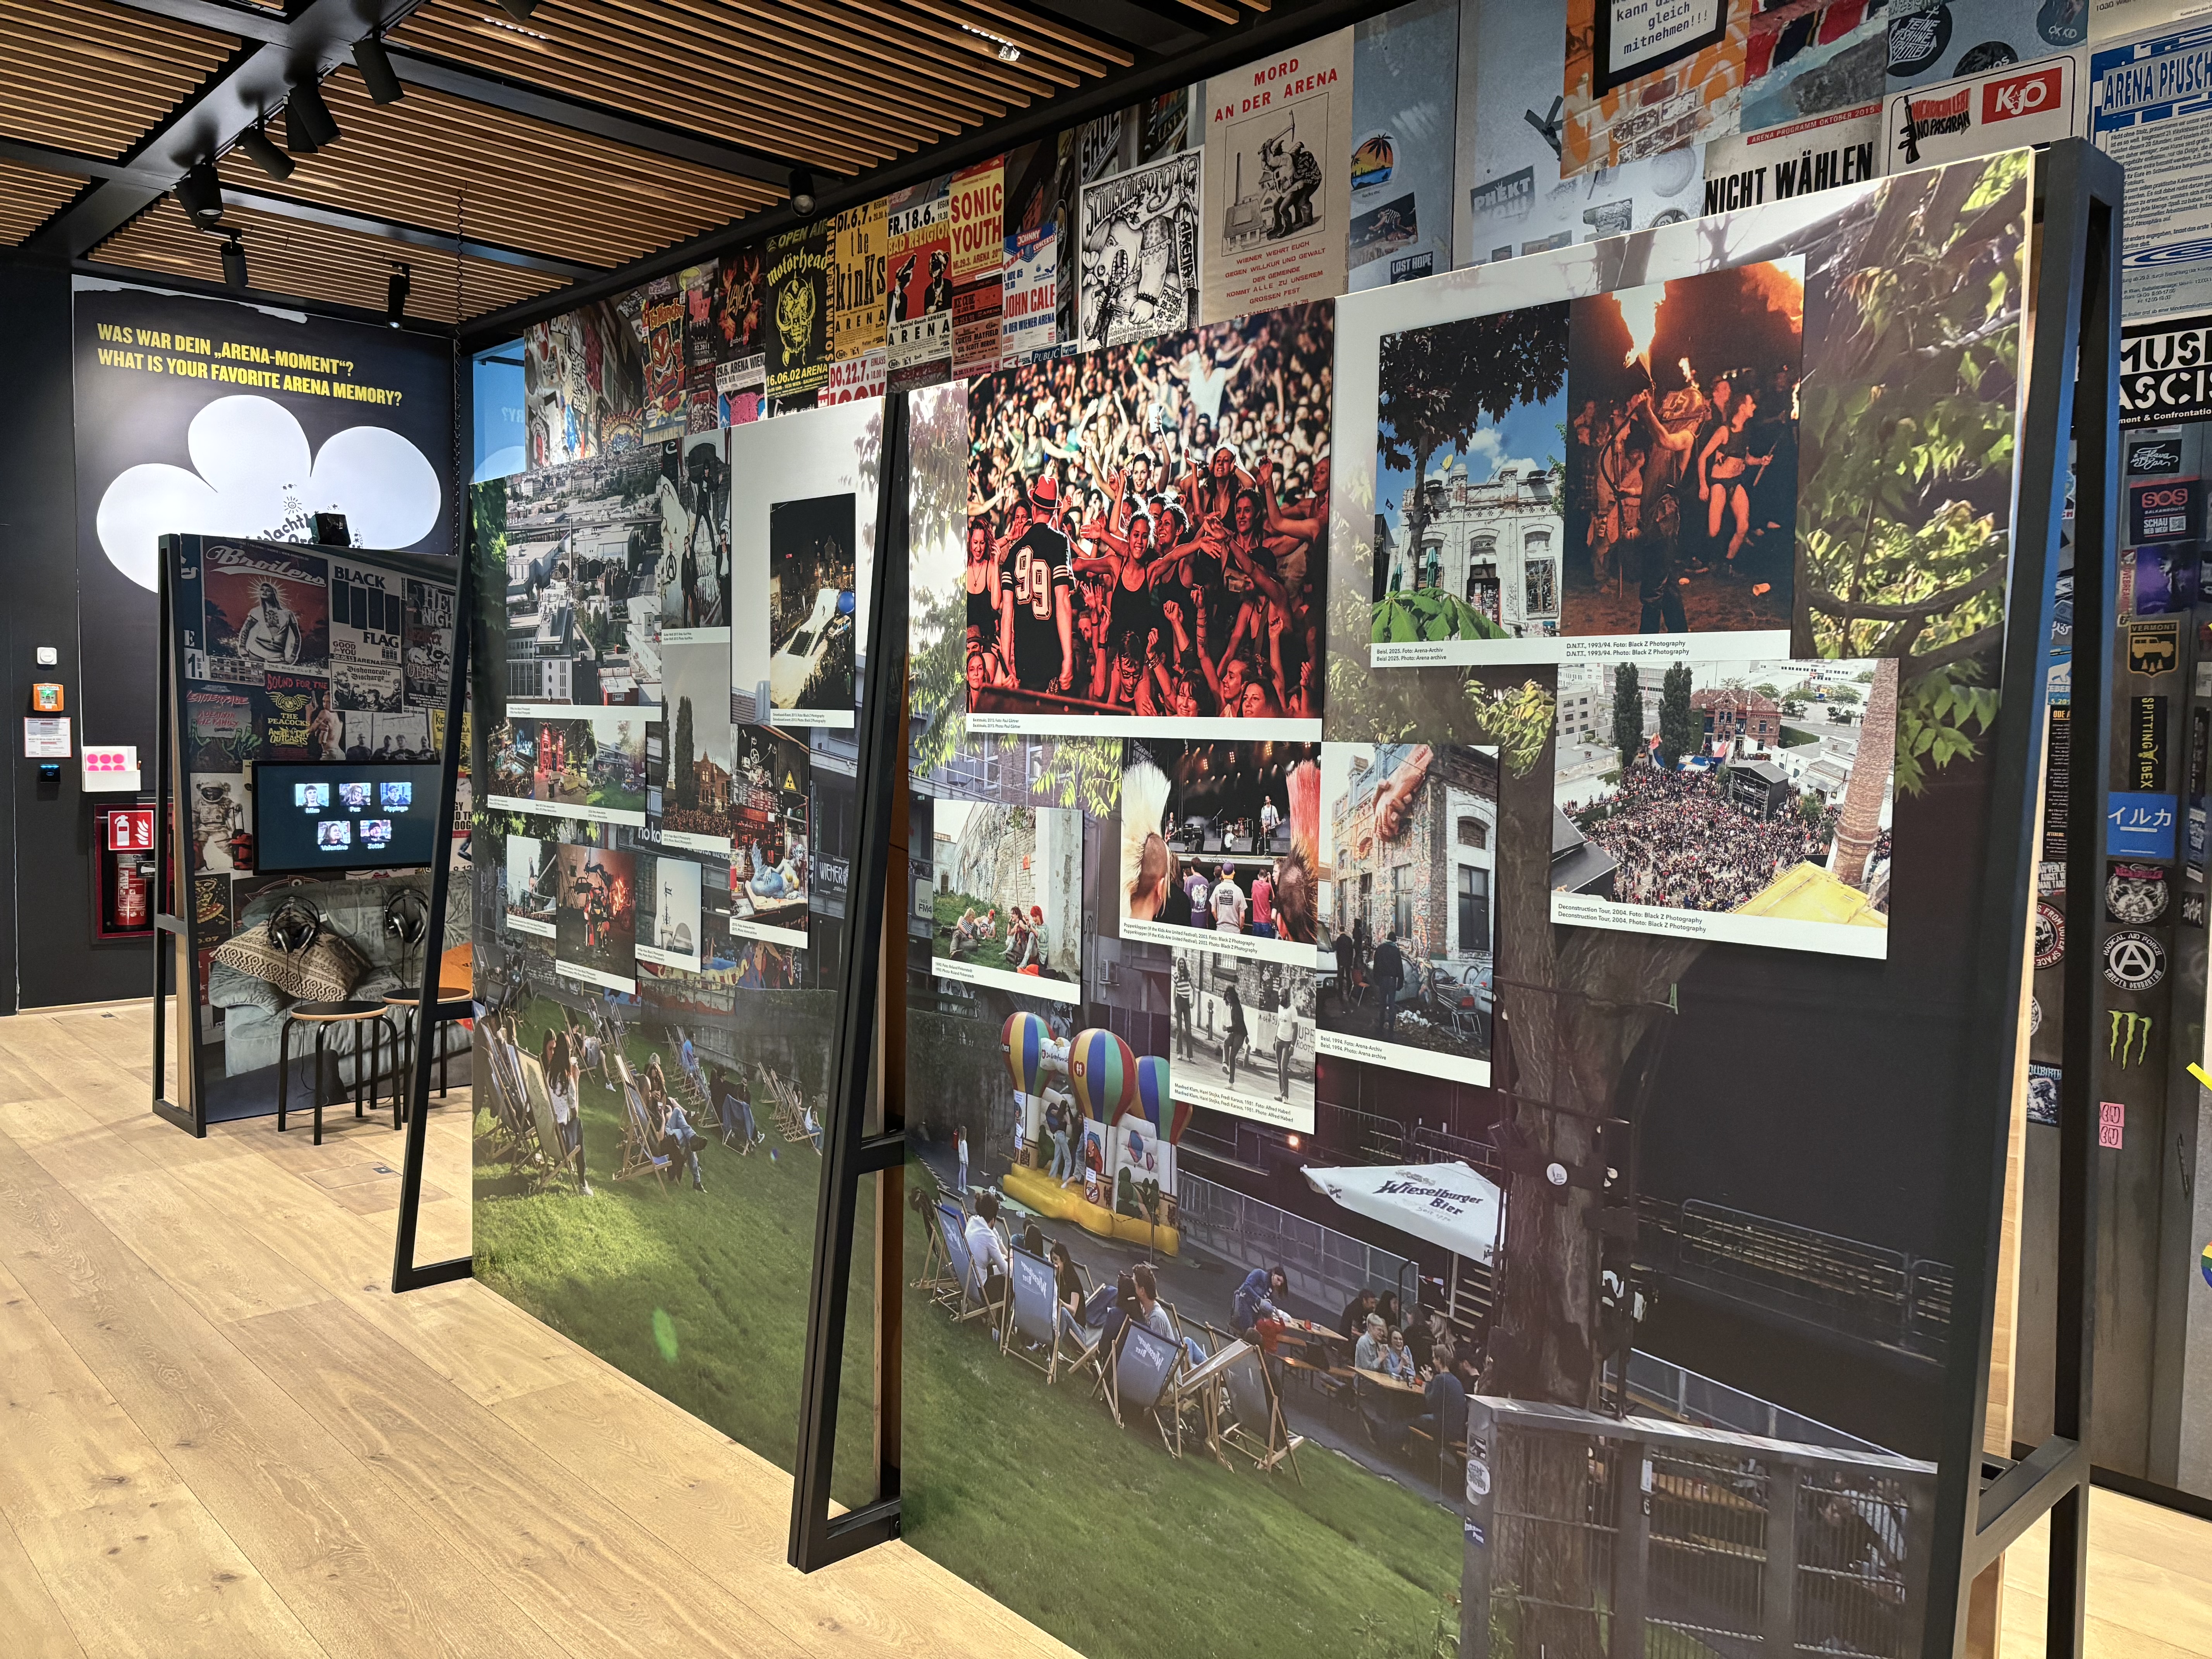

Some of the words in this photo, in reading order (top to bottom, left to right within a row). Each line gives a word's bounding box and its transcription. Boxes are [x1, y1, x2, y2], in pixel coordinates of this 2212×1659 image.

[1617, 2, 1648, 22] kann
[1648, 3, 1690, 30] gleich
[1624, 10, 1707, 55] mitnehmen!!!
[1254, 58, 1299, 86] MORD
[1214, 104, 1234, 123] AN
[1242, 91, 1271, 113] DER
[1284, 67, 1338, 99] ARENA
[2103, 65, 2154, 111] ARENA
[1751, 131, 1774, 143] ARENA
[1776, 120, 1818, 137] PROGRAMM
[1819, 112, 1852, 127] OKTOBER
[1855, 106, 1875, 117] 2015
[1916, 118, 1929, 140] NO
[1930, 110, 1971, 136] PASARAN
[1705, 167, 1767, 216] NICHT
[1776, 141, 1874, 201] WÄHLEN
[951, 182, 1003, 224] SONIC
[778, 232, 806, 249] OPEN
[851, 227, 869, 257] the
[888, 235, 905, 256] BAD
[909, 221, 950, 249] RELIGION
[951, 215, 1002, 256] YOUTH
[1017, 228, 1041, 246] JOHNNY
[1033, 234, 1056, 251] CONCERTS
[1225, 269, 1247, 278] GEGEN
[1282, 256, 1296, 264] UND
[1298, 248, 1326, 259] GEWALT
[1237, 254, 1262, 265] WIENER
[1266, 247, 1290, 257] WEHRT
[1291, 240, 1310, 251] EUCH
[1392, 259, 1410, 274] LOST
[1412, 253, 1432, 270] HOPE
[767, 246, 828, 287] motörhead
[1253, 275, 1265, 283] DER
[1268, 266, 1300, 279] GEMEINDE
[1226, 289, 1250, 298] KOMMT
[1253, 283, 1273, 293] ALLE
[1291, 270, 1323, 283] UNSEREM
[1249, 293, 1281, 304] GROSSEN
[1284, 287, 1301, 296] FEST
[1004, 291, 1028, 320] JOHN
[1030, 283, 1055, 313] CALE
[835, 310, 886, 333] ARENA
[888, 319, 950, 347] ARENA
[1003, 325, 1008, 335] IN
[1009, 322, 1018, 332] DER
[1018, 317, 1037, 330] WIENER
[1038, 313, 1055, 326] ARENA
[97, 323, 133, 344] WAS
[136, 329, 172, 350] WAR
[175, 336, 211, 356] DEIN
[955, 335, 972, 345] CURTIS
[974, 329, 998, 340] MAYFIELD
[966, 342, 979, 350] SCOTT
[981, 339, 996, 348] HERON
[716, 364, 730, 375] 29.6.
[730, 360, 749, 373] ARENA
[750, 356, 765, 370] WIEN
[1034, 348, 1060, 362] PUBLIC
[97, 348, 143, 369] WHAT
[148, 355, 163, 373] IS
[167, 358, 208, 379] YOUR
[211, 366, 281, 390] FAVORITE
[283, 376, 331, 397] ARENA
[333, 382, 402, 407] MEMORY?
[766, 369, 801, 387] 16.06.02
[802, 364, 828, 377] ARENA
[2142, 488, 2188, 508] SOS
[2144, 517, 2168, 528] SCHAU
[206, 545, 327, 587] Broilers
[334, 565, 387, 589] BLACK
[1014, 545, 1052, 620] 99
[333, 641, 356, 650] GOOD
[340, 647, 356, 656] YOU
[363, 631, 399, 649] FLAG
[267, 674, 294, 690] BOUND
[295, 679, 312, 690] FOR
[268, 718, 310, 726] PEACOCKS
[2142, 697, 2154, 750] SPITTING
[2140, 761, 2154, 788] IBEX
[2108, 806, 2172, 827] イルカ
[819, 862, 843, 885] WIENER
[1558, 904, 1597, 912] Deconstruction
[1666, 915, 1702, 924] Photography
[1558, 911, 1597, 920] Deconstruction
[1669, 922, 1706, 933] Photography
[2043, 907, 2063, 925] FROM
[2142, 936, 2162, 956] FORCE
[2037, 950, 2061, 966] SPACE
[1296, 1040, 1314, 1054] ROOTS
[1355, 1043, 1382, 1052] Arena-Archiv
[1373, 1180, 1484, 1205] Wieselburger
[1429, 1198, 1465, 1216] Bier
